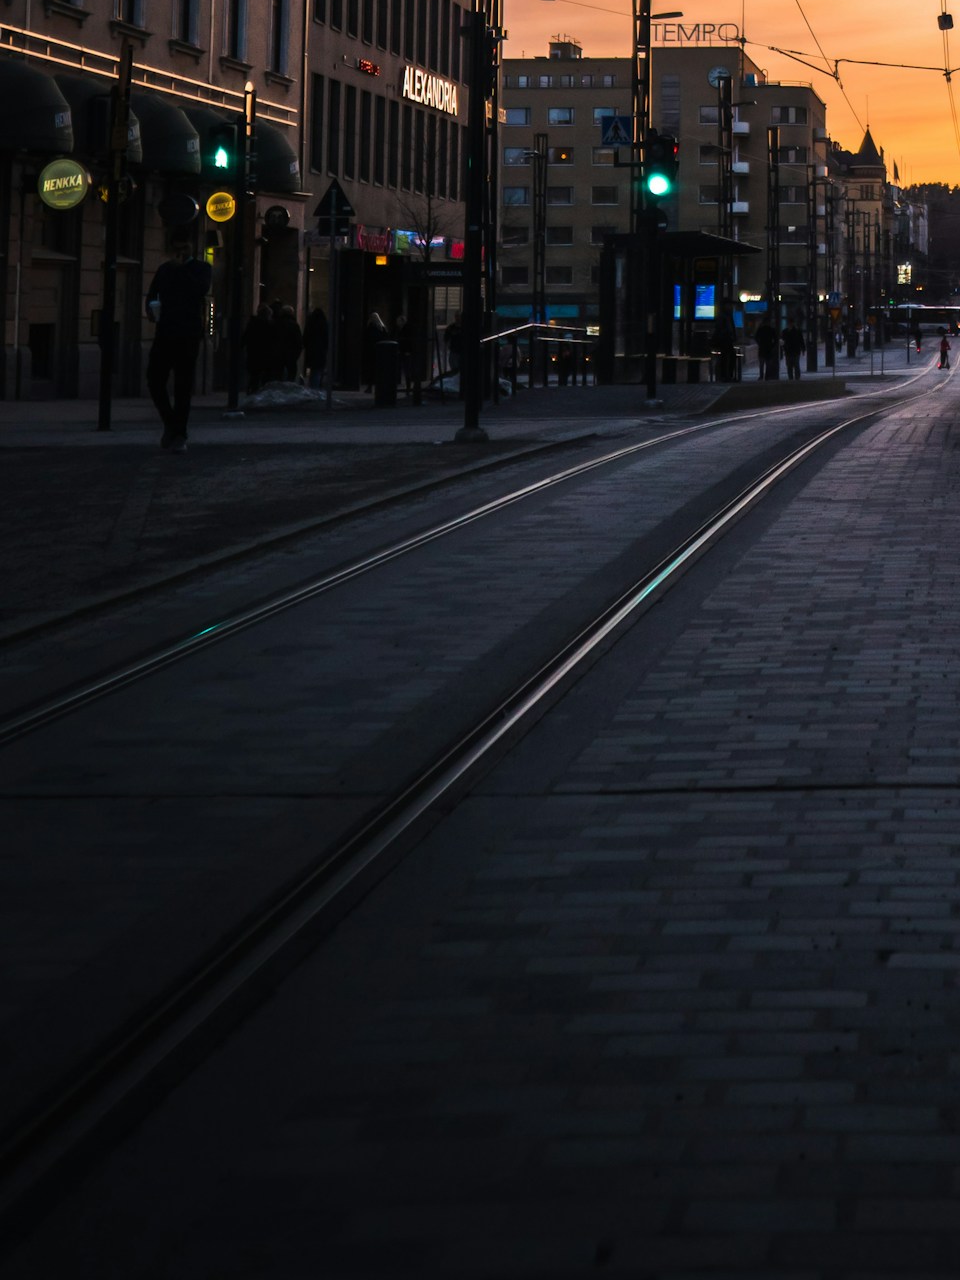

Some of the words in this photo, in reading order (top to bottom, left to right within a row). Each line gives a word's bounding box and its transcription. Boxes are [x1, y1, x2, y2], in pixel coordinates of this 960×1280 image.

[650, 23, 739, 42] TEMPO
[402, 65, 459, 117] ALEXANDRIA
[43, 174, 83, 193] HENKKA
